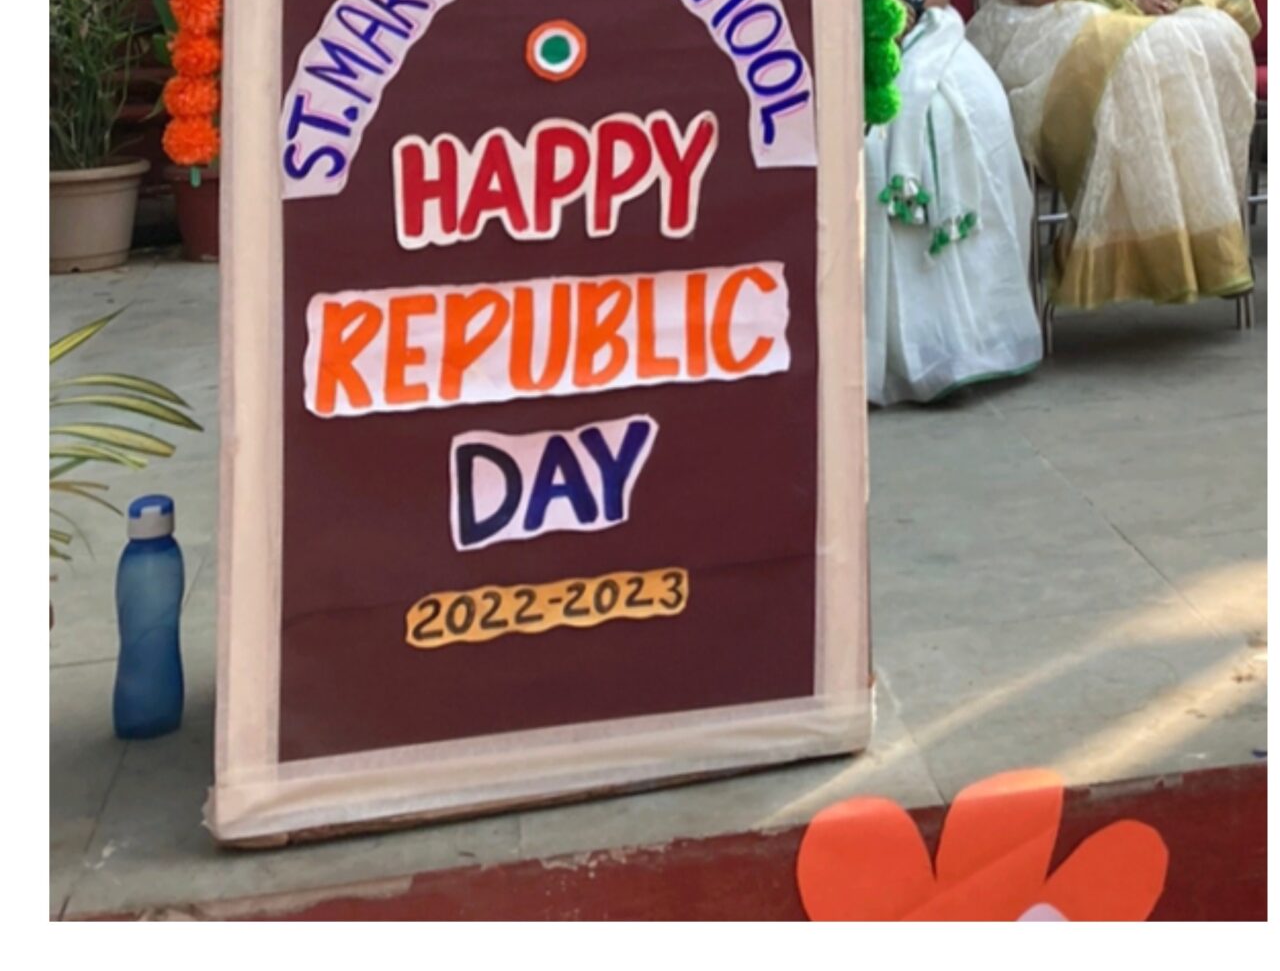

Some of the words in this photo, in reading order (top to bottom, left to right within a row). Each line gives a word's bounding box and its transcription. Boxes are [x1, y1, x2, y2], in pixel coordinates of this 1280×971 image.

[283, 95, 359, 180] ST.
[400, 118, 715, 237] HAPPY
[314, 266, 778, 415] REPUBLIC
[456, 420, 651, 547] DAY
[411, 571, 684, 641] 2022-2023
